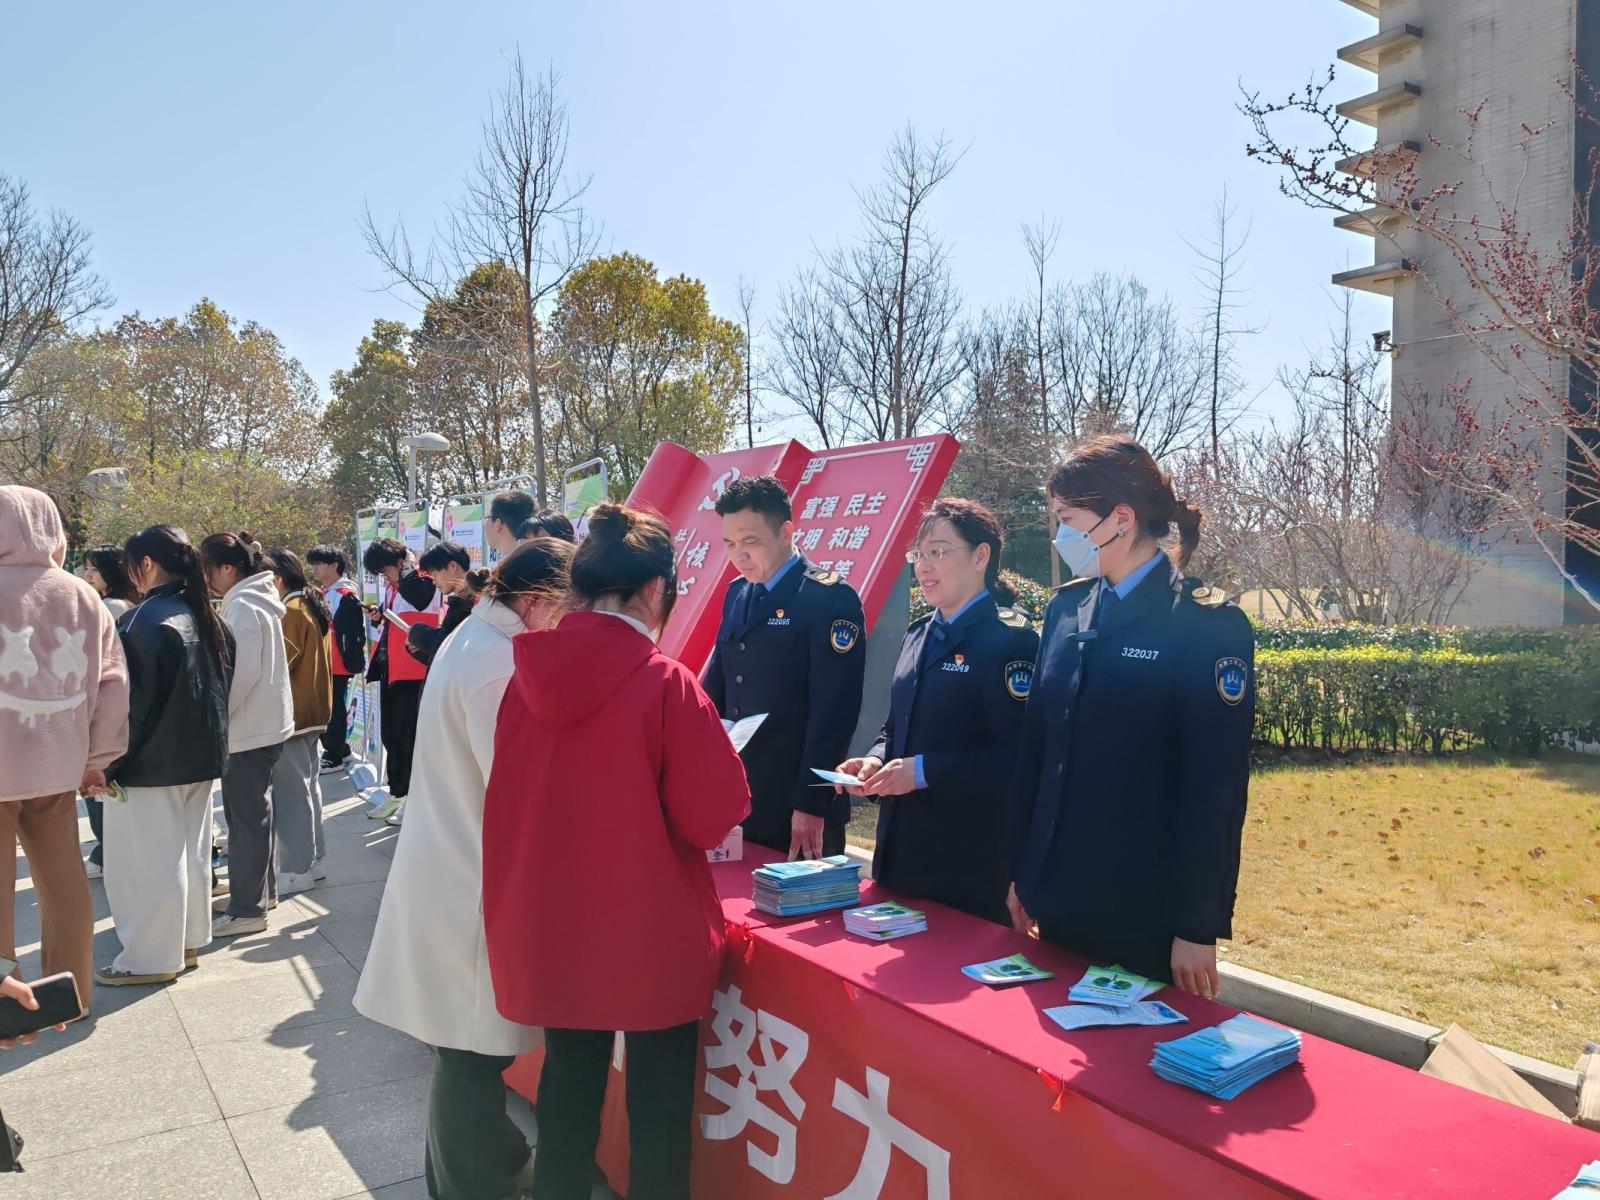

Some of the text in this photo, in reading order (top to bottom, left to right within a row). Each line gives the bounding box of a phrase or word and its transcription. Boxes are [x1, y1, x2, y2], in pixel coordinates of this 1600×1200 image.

[800, 492, 886, 520] 富强 民主
[827, 525, 870, 551] 和谐
[1121, 647, 1160, 661] 322037
[700, 983, 951, 1200] 努力
